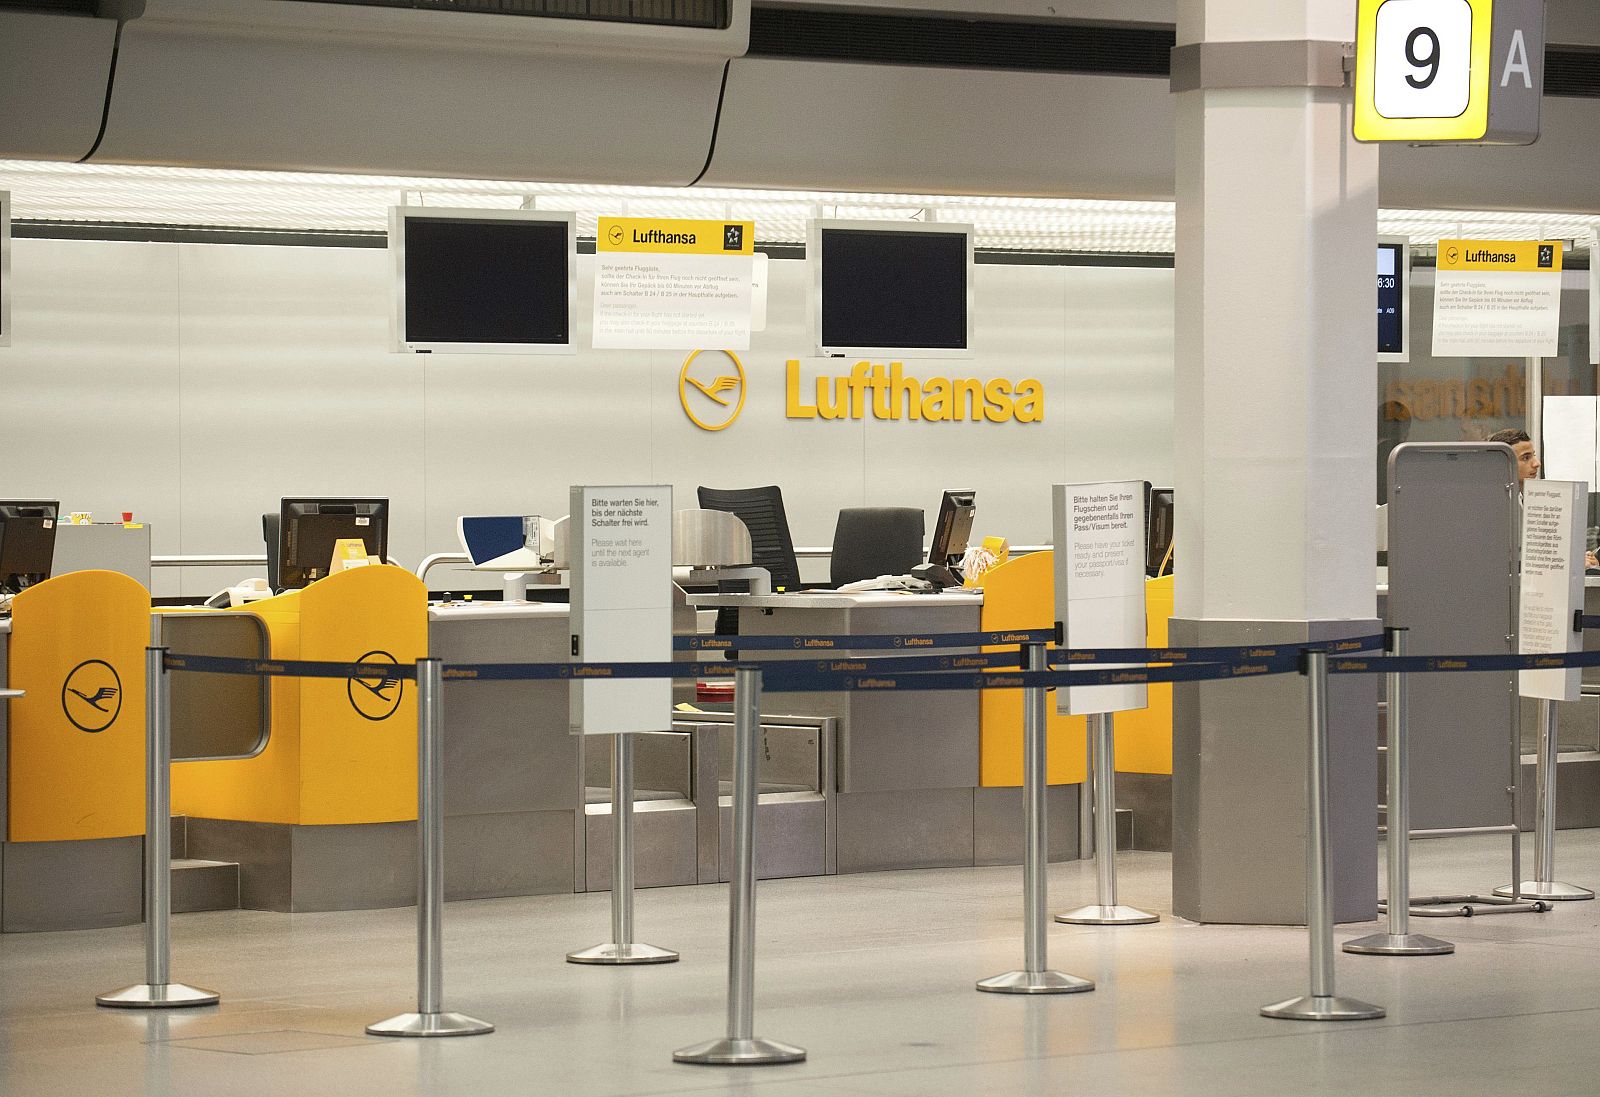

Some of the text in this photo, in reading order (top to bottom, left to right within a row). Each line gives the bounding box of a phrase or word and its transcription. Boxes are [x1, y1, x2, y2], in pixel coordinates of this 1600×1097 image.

[1405, 26, 1440, 89] 9
[1500, 29, 1532, 88] A
[633, 229, 696, 244] Lufthansa
[1465, 250, 1516, 263] Lufthansa
[786, 360, 1043, 423] Lufthansa
[592, 499, 608, 507] Bitte
[634, 498, 645, 506] Sie
[646, 498, 659, 507] hier,
[1074, 496, 1088, 504] Bitte
[1089, 495, 1108, 503] halten
[1109, 494, 1118, 502] Sie
[592, 509, 642, 517] bis der nächste
[1074, 505, 1106, 513] Flugschein
[592, 518, 649, 527] Schalter frei wird.
[1074, 514, 1119, 523] gegebenenfalls
[1074, 522, 1128, 531] Pass/Visum bereit.
[592, 539, 613, 547] Please
[615, 539, 627, 547] wait
[592, 549, 605, 557] until
[633, 549, 649, 558] agent
[701, 634, 1030, 647] Lufthansa Lufthansa Lufthansa Lufthansa
[831, 658, 988, 670] Lufthansa Lufthansa
[442, 668, 478, 677] ufthansa
[573, 667, 612, 676] Lufthansa
